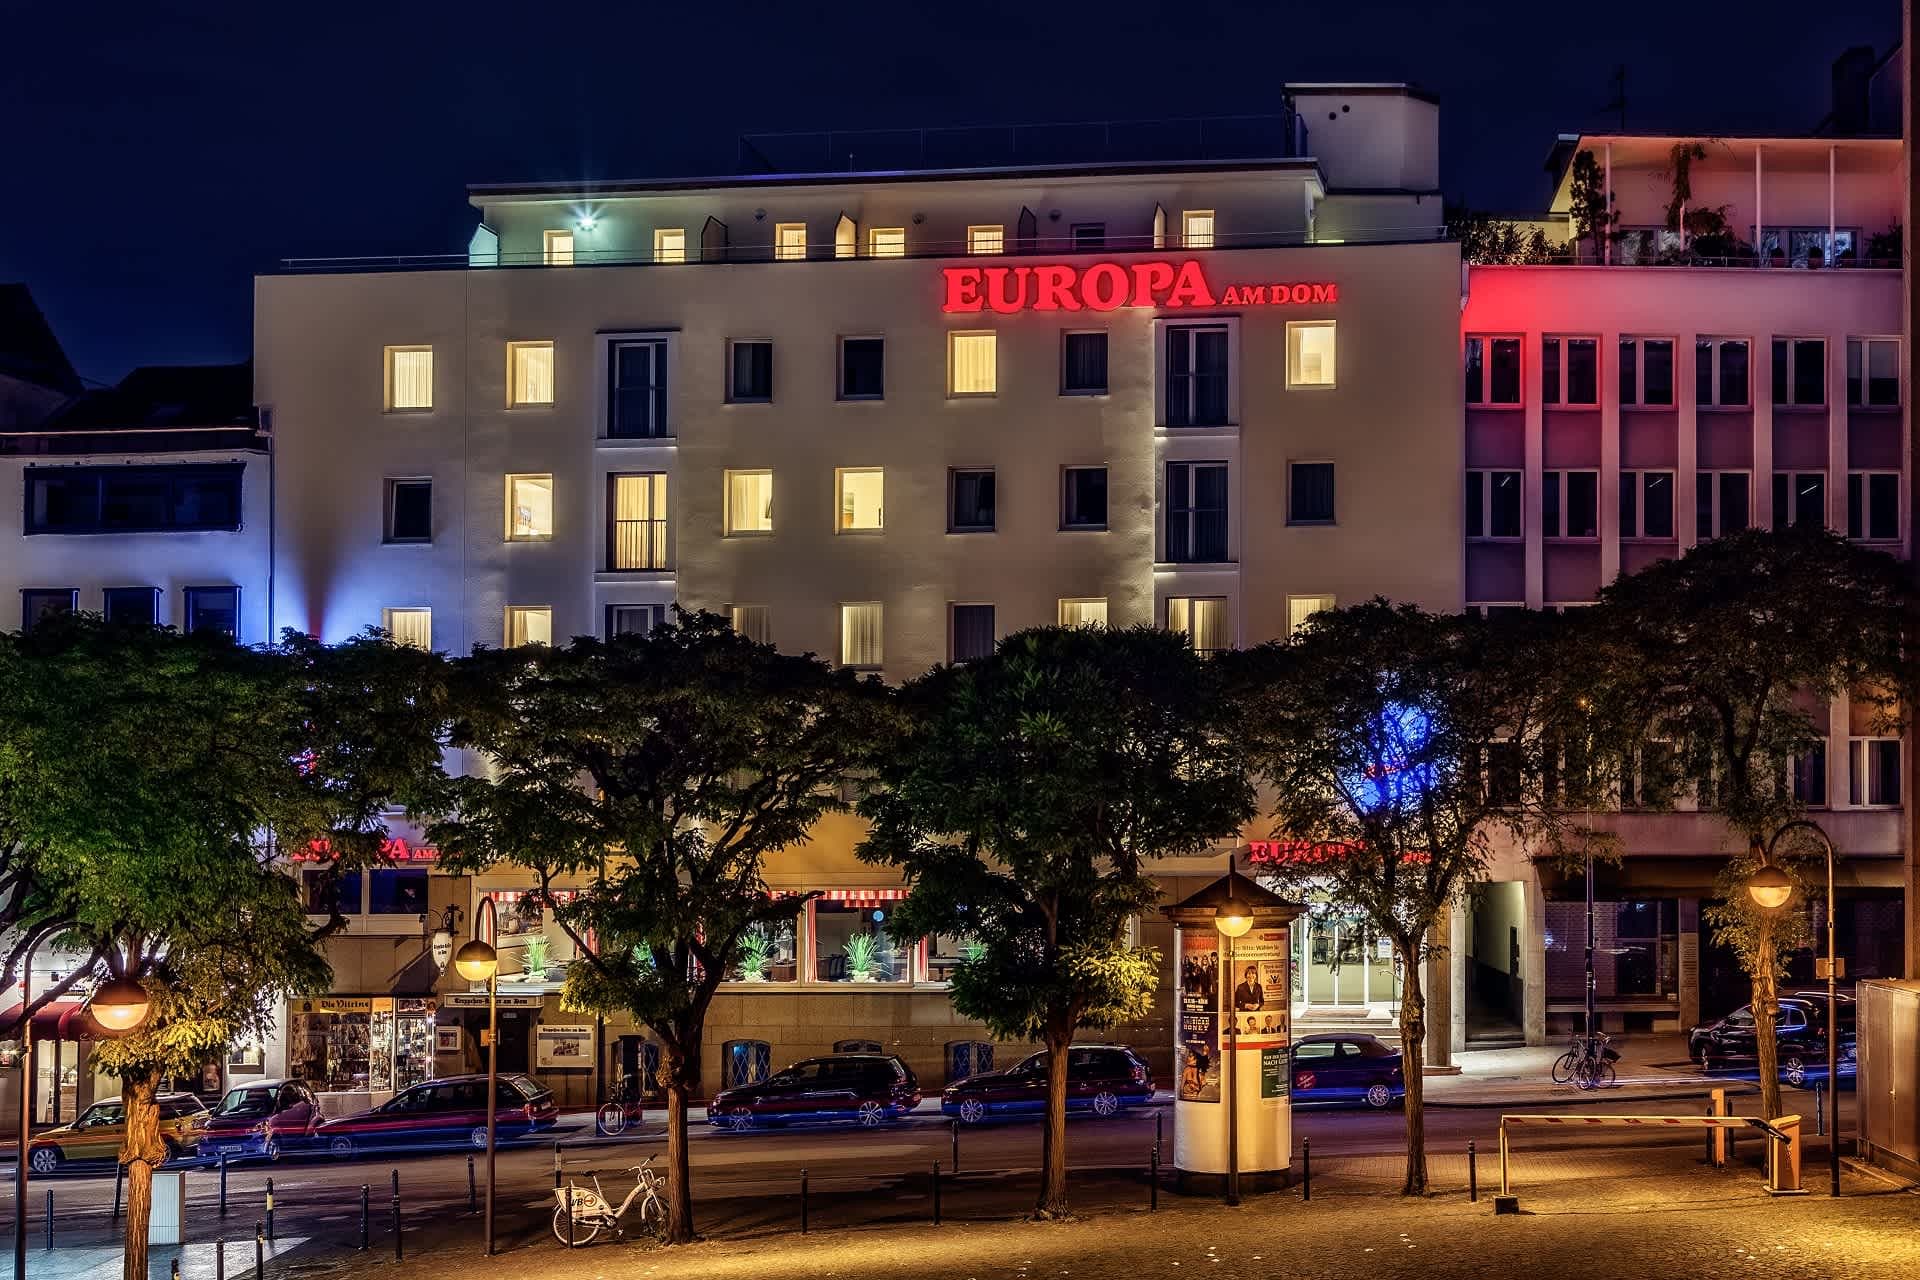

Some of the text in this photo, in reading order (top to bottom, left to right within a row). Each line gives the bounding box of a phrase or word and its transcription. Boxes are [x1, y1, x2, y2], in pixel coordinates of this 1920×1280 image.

[943, 261, 1337, 313] EUROPA AM DOM
[414, 849, 432, 859] AM
[321, 1000, 335, 1008] Die
